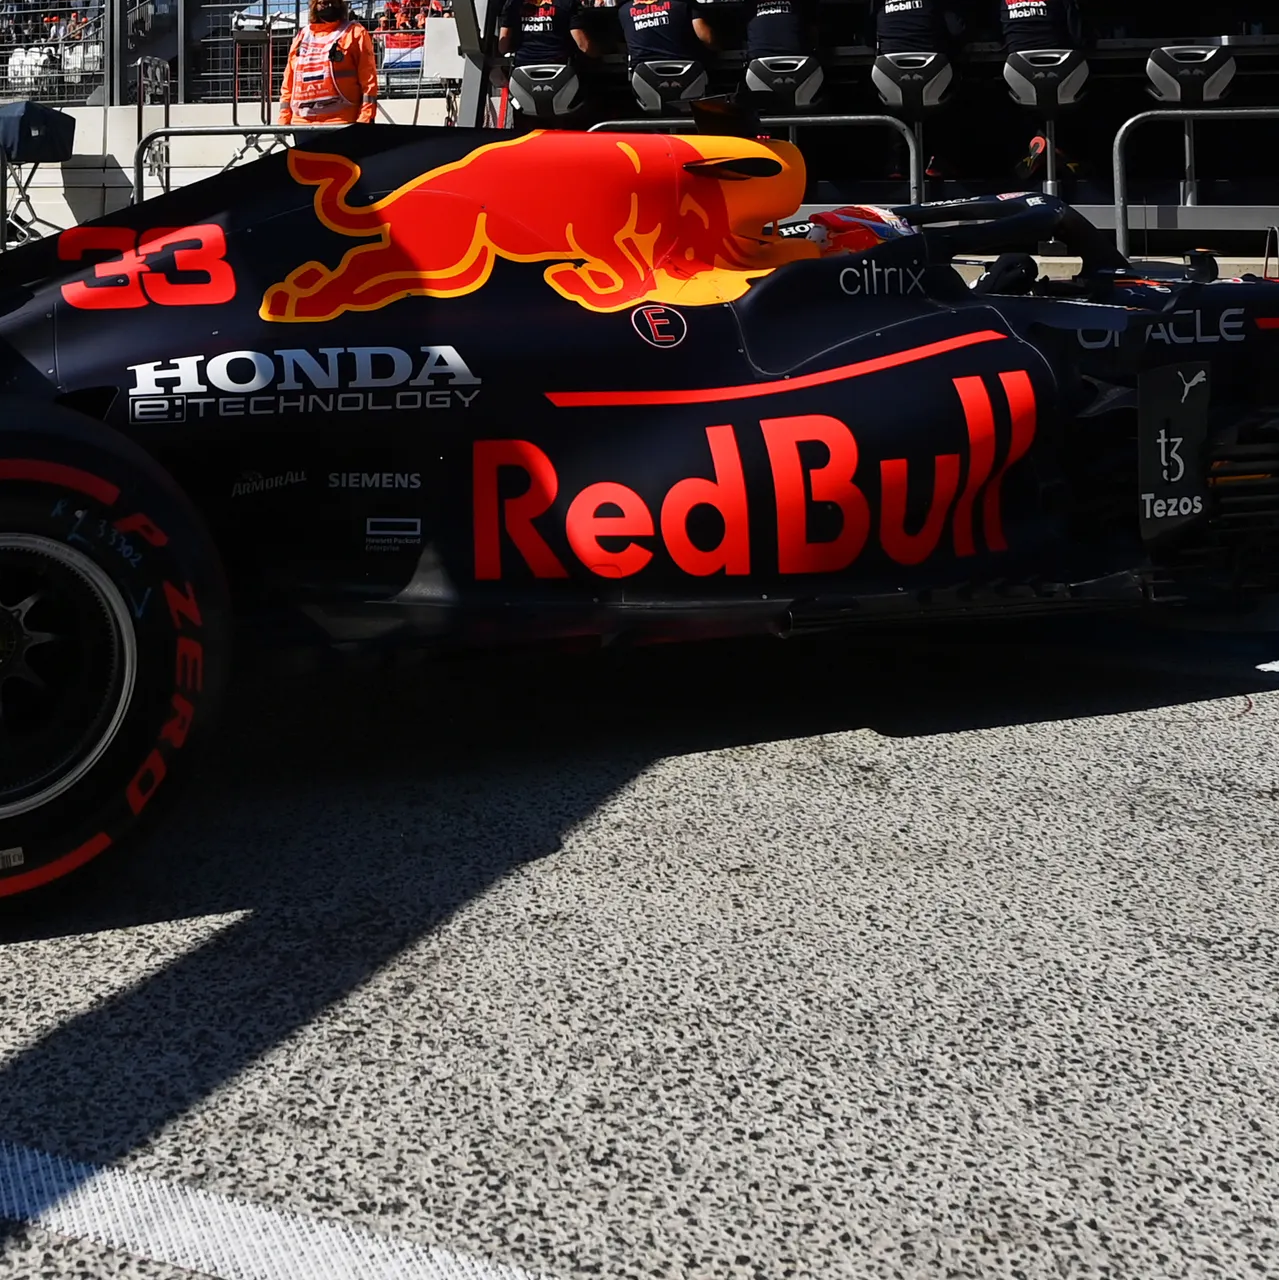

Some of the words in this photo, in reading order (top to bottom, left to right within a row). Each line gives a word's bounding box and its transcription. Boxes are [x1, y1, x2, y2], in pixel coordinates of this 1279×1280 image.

[635, 18, 660, 31] Mobil
[885, 1, 912, 14] Mobil
[920, 196, 980, 208] ORACLE
[58, 223, 237, 310] 33
[839, 258, 926, 296] citrix
[1077, 307, 1247, 350] OACLE
[127, 345, 482, 396] HONDA
[328, 472, 422, 489] SIEMENS
[472, 423, 752, 580] Red
[758, 369, 1039, 576] Bull
[1141, 493, 1203, 518] Tezos
[112, 511, 169, 548] P
[126, 580, 203, 816] ZERO
